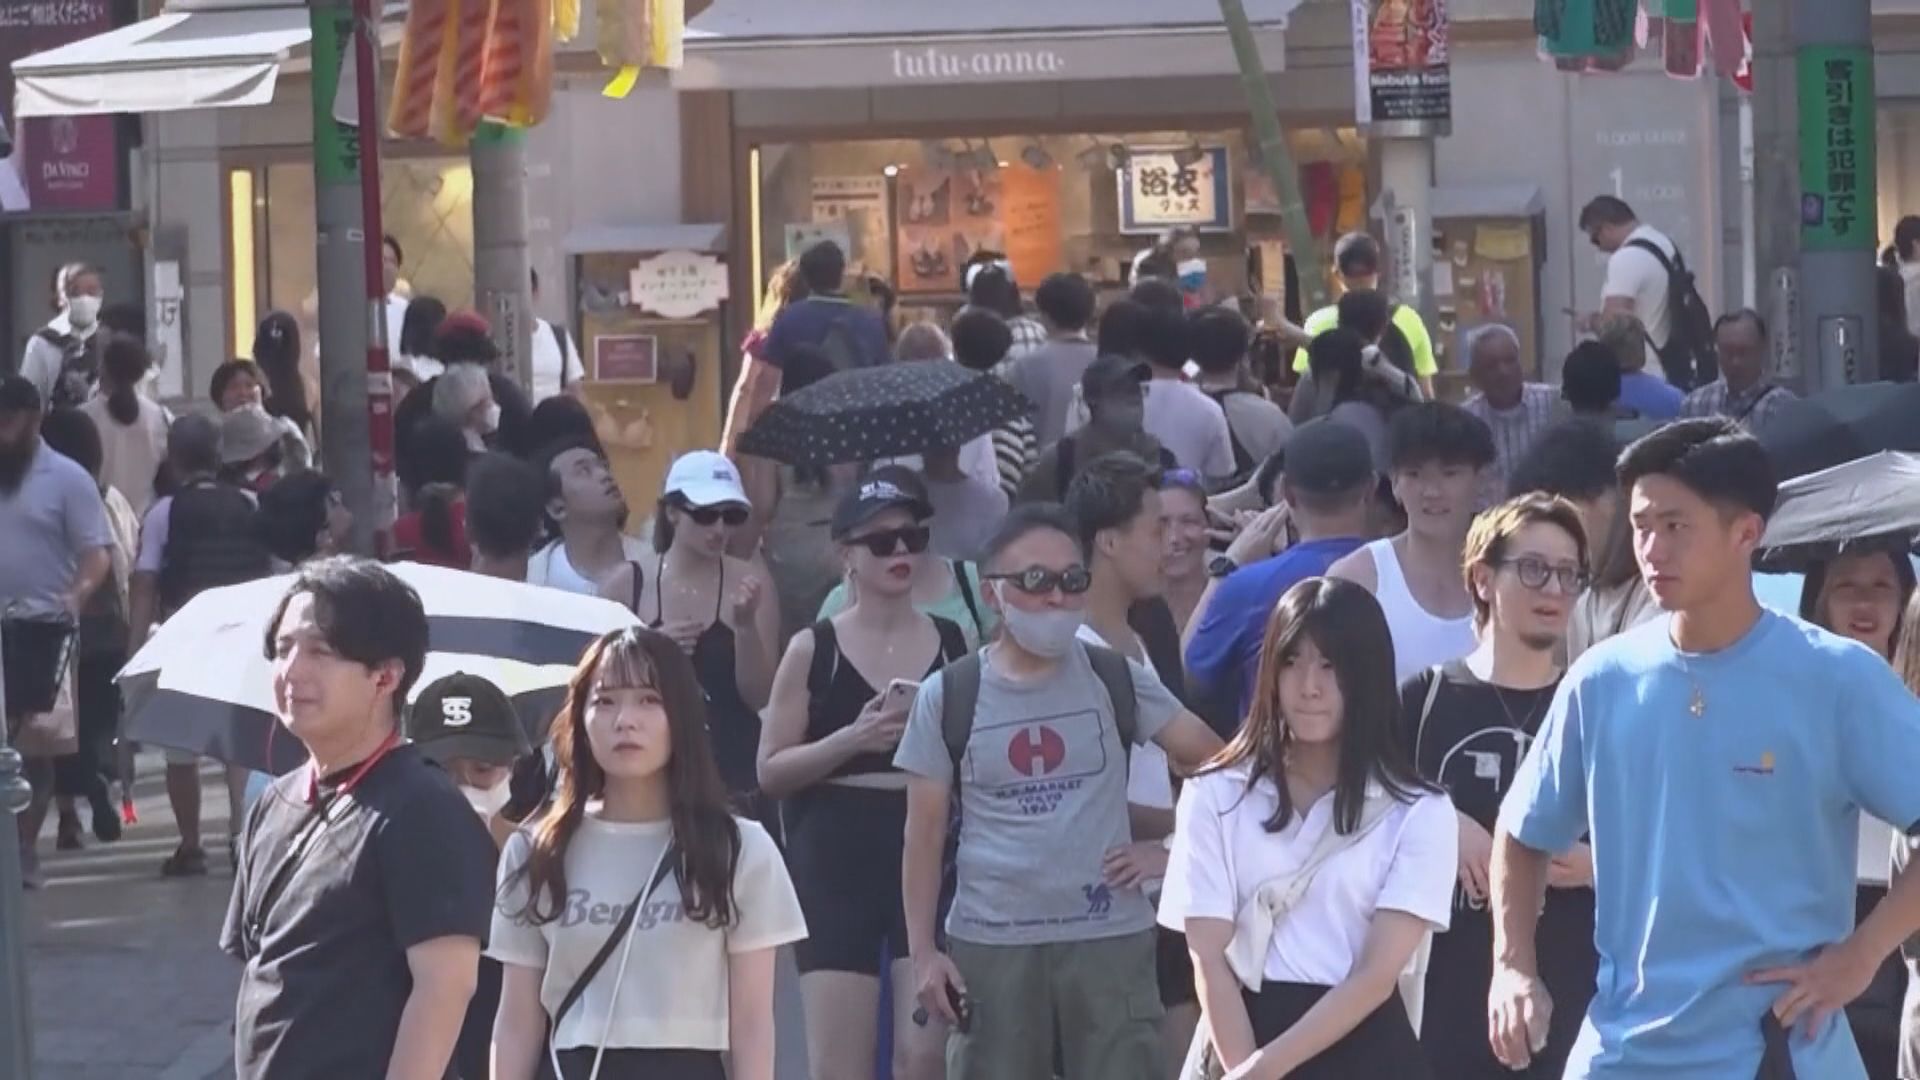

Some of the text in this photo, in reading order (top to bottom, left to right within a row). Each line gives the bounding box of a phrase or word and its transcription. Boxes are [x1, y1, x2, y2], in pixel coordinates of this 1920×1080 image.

[1140, 166, 1199, 198] 浴衣
[1824, 59, 1856, 236] 客引きは犯罪です
